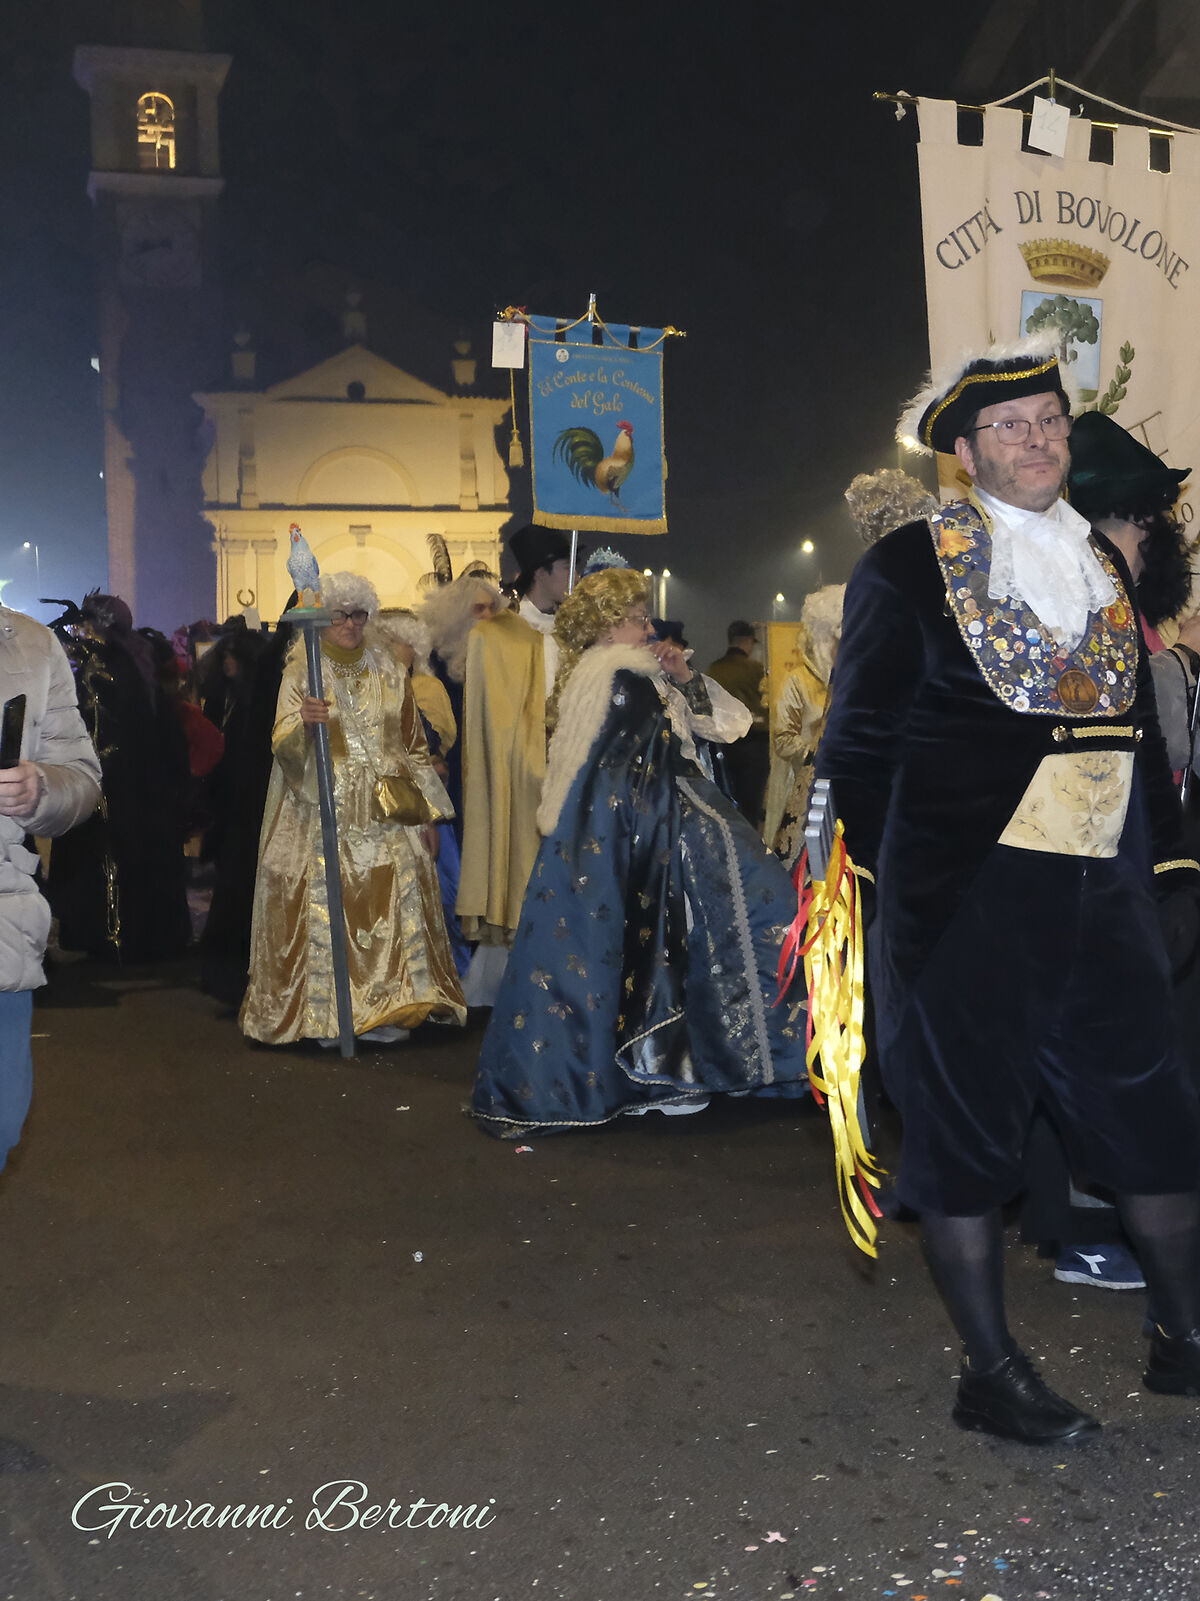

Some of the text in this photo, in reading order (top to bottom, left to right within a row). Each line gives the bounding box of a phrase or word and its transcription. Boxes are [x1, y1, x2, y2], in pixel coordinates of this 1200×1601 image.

[1014, 190, 1043, 225] DI
[1056, 190, 1190, 290] BOVOLONE
[553, 371, 587, 389] Conte
[598, 367, 608, 384] la
[571, 390, 624, 416] del Galo
